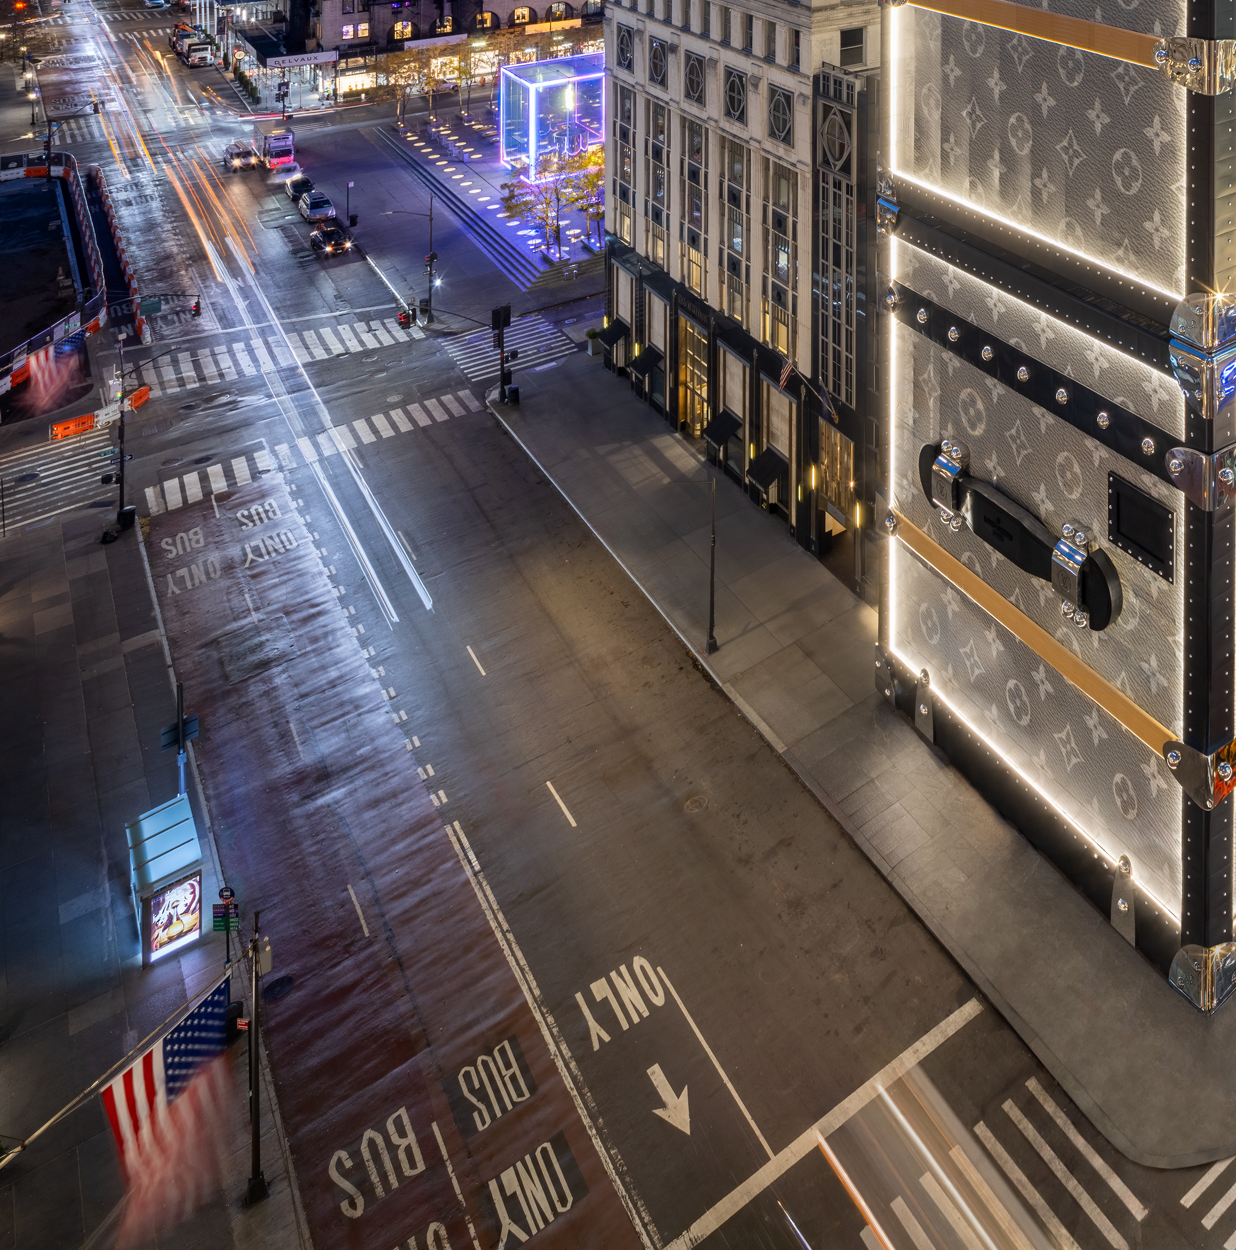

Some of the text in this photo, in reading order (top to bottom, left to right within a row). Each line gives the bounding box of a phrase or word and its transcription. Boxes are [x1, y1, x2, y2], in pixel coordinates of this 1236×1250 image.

[274, 55, 319, 65] DELVAUX
[236, 498, 282, 531] BUS
[160, 526, 205, 559] BUS
[244, 528, 299, 568] ONLY
[166, 557, 221, 597] ONLY
[574, 955, 666, 1052] ONLY
[457, 1039, 531, 1132] BUS
[328, 1105, 426, 1219] BUS
[488, 1141, 574, 1250] ONLY
